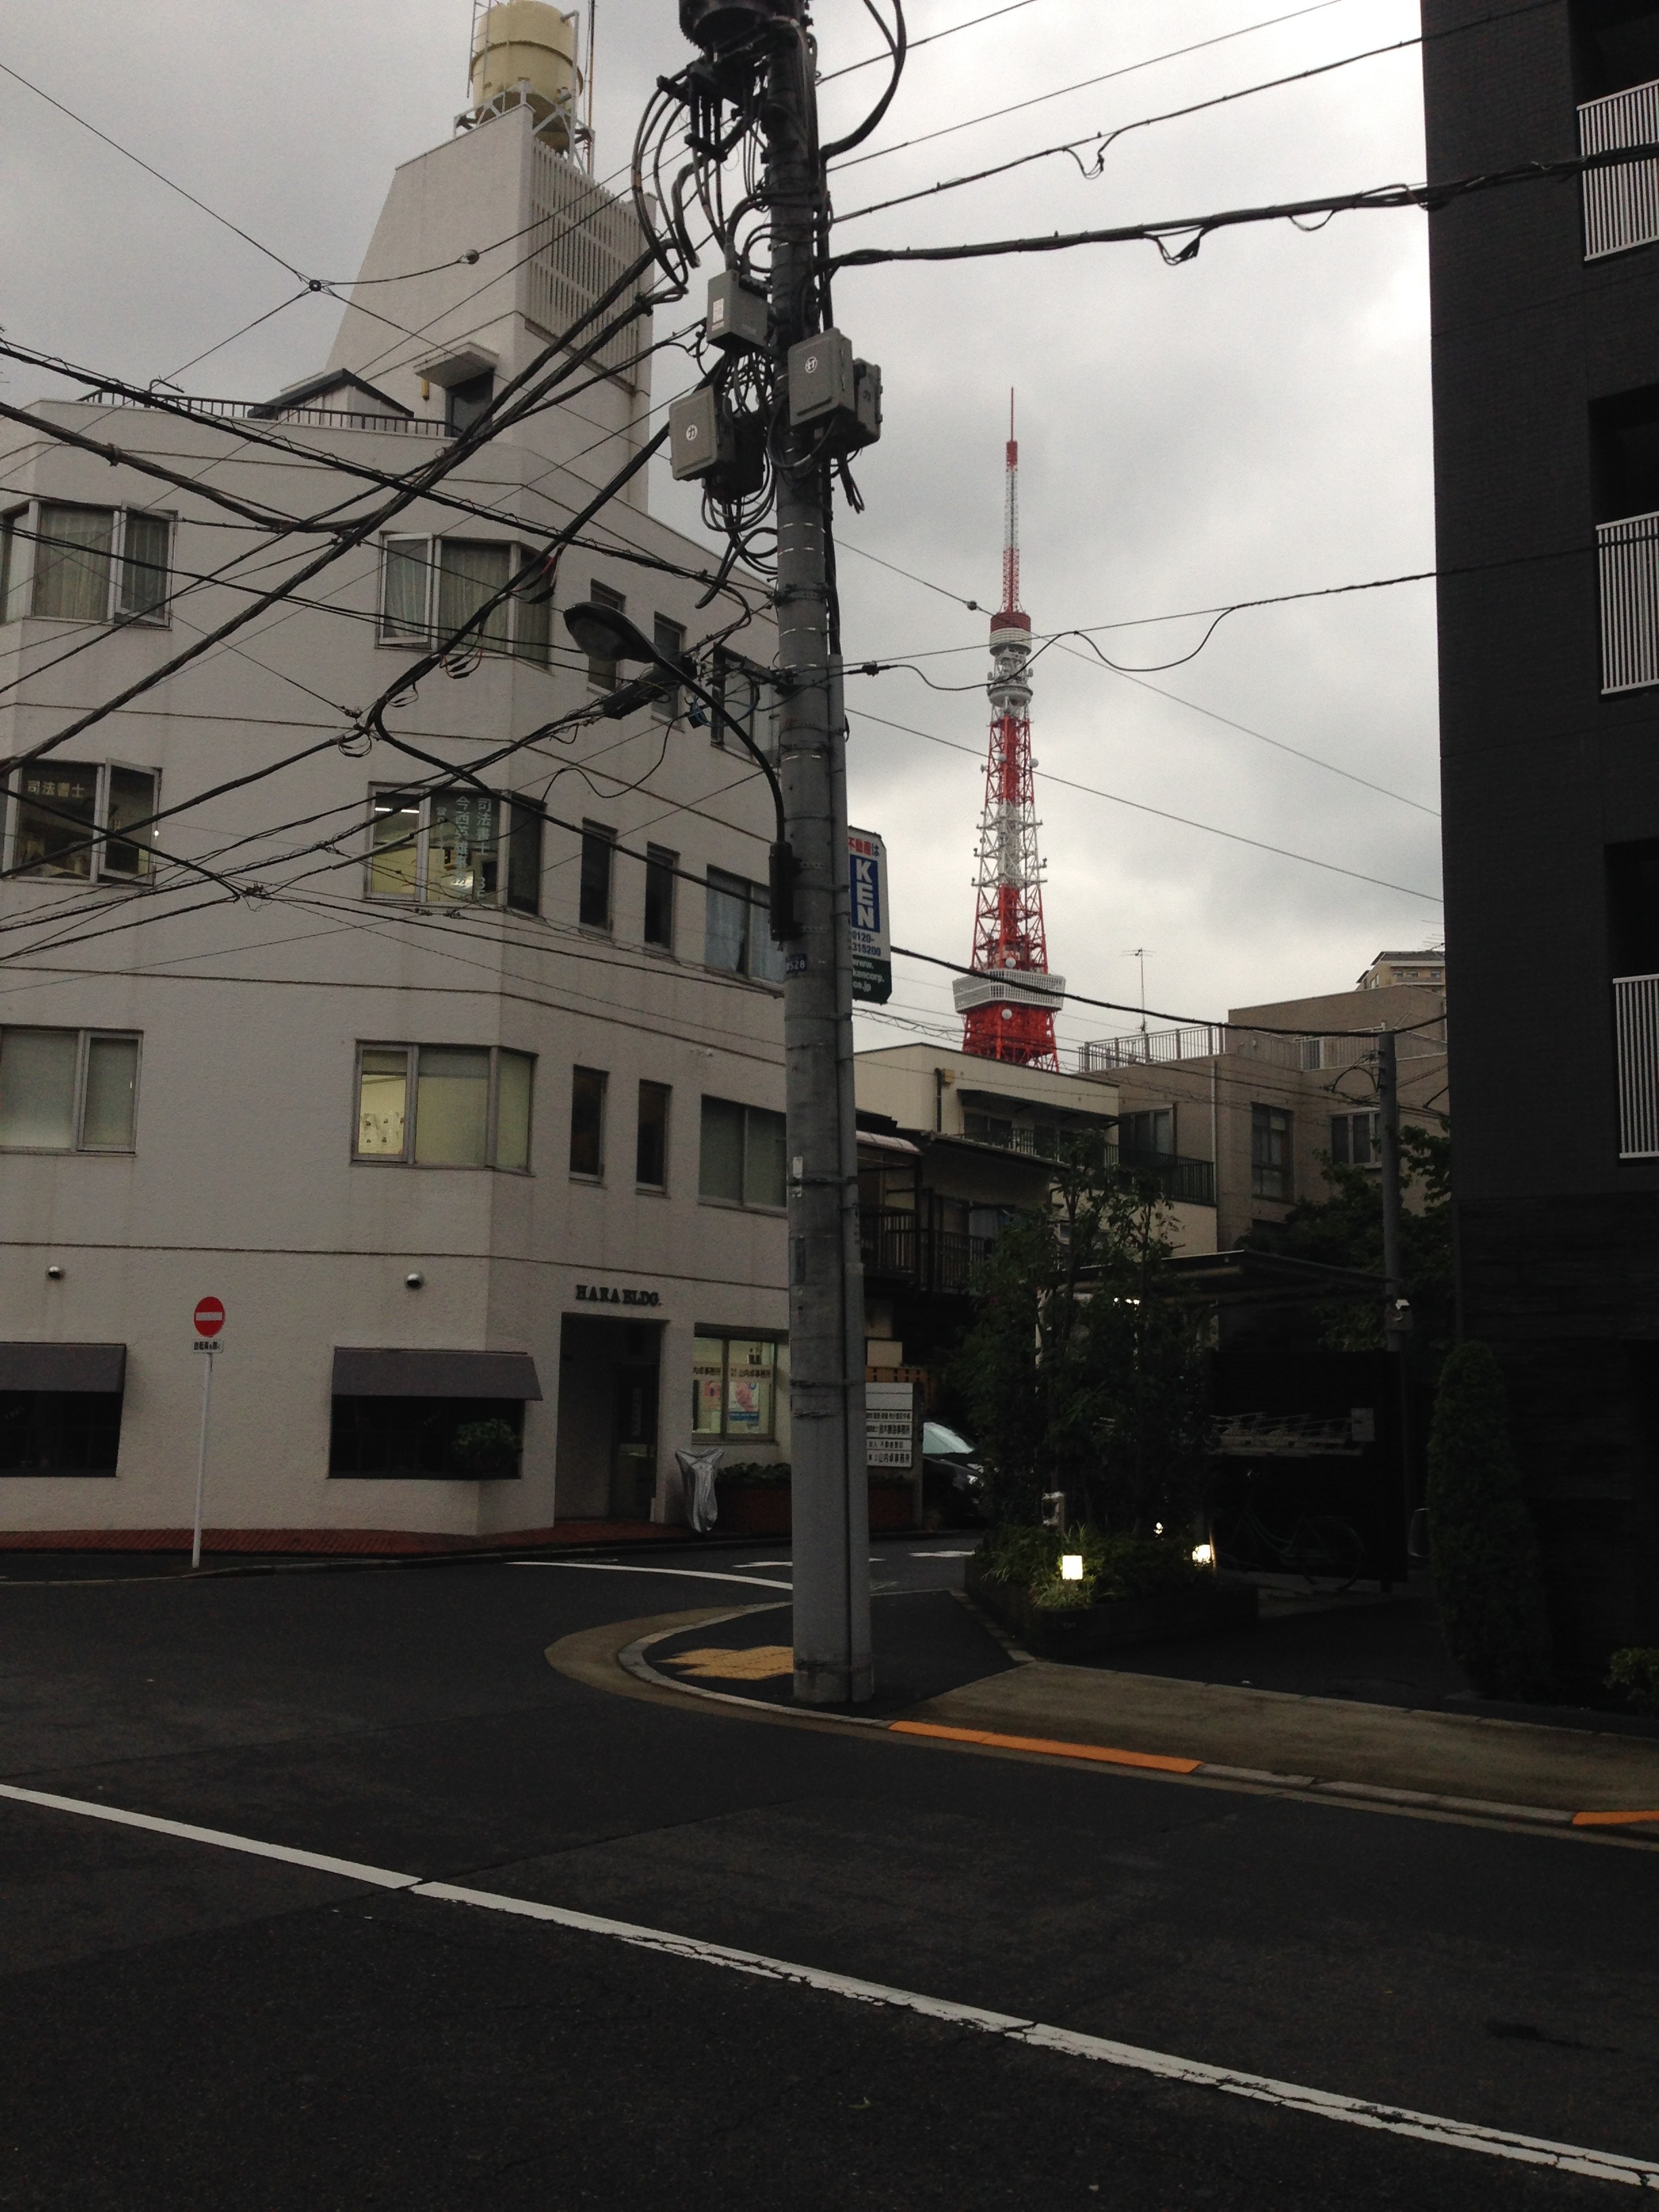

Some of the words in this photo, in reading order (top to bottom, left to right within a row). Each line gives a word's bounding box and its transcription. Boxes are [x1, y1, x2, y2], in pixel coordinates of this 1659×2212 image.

[28, 781, 85, 798] 司法書士
[476, 798, 491, 855] 司法書士
[848, 836, 879, 857] 不動産は
[855, 858, 874, 930] KEN
[576, 1284, 621, 1303] HARA
